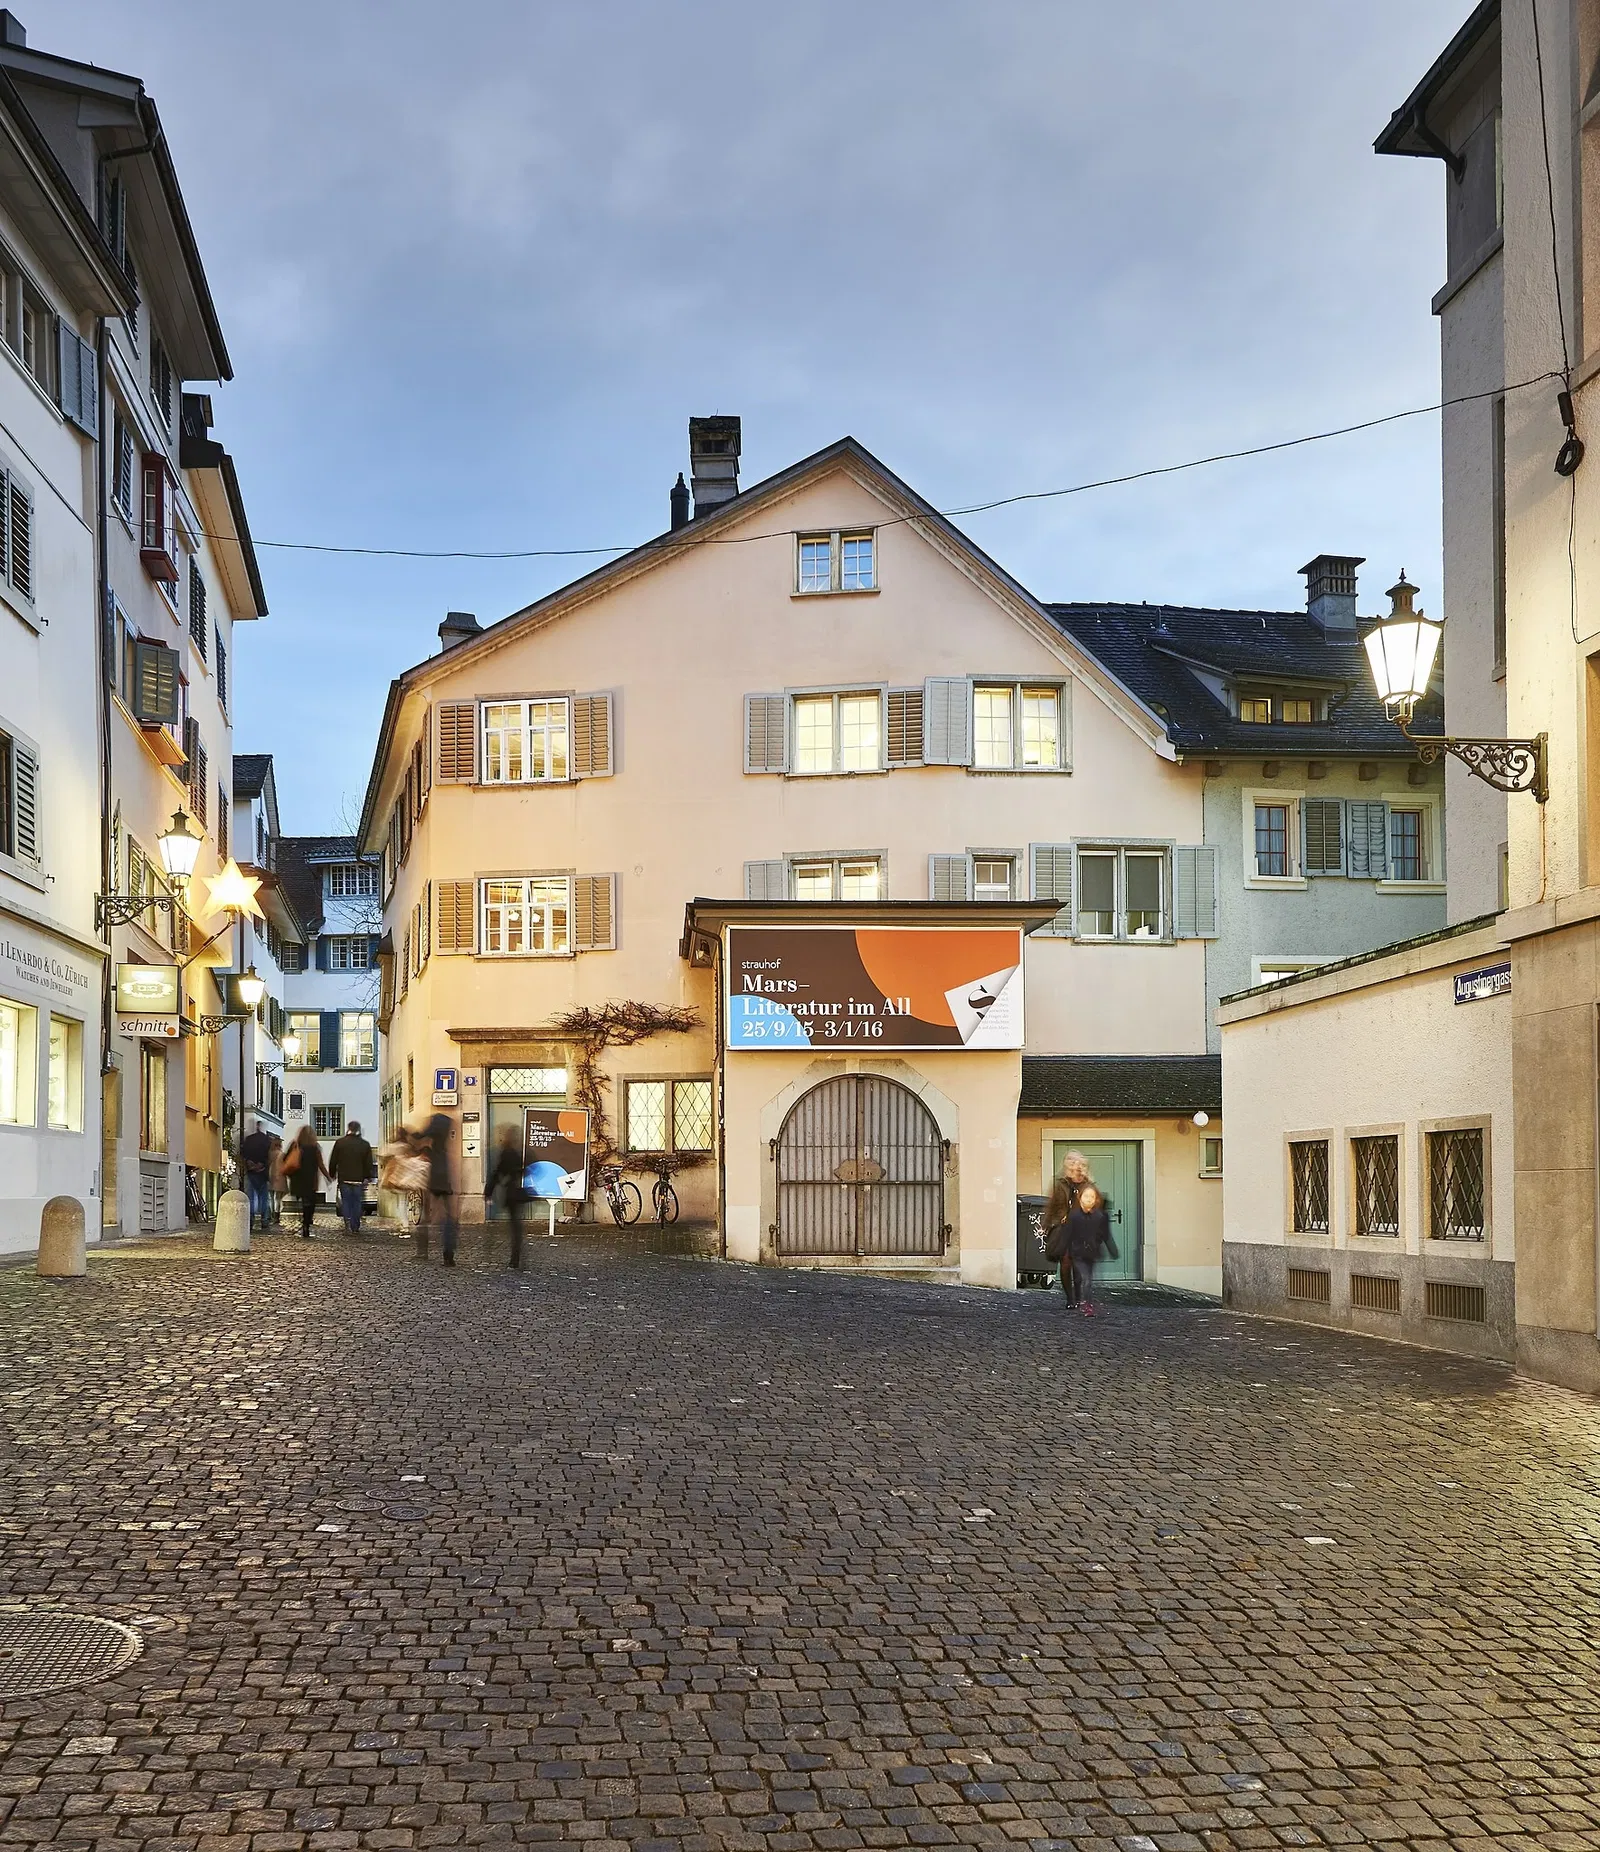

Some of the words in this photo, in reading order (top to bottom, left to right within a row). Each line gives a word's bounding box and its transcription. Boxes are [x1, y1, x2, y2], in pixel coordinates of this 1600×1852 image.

[44, 956, 50, 974] &
[741, 958, 782, 969] strauhof
[1456, 969, 1511, 999] Augustinergas
[742, 997, 842, 1016] Literatur
[847, 997, 876, 1016] im
[880, 997, 912, 1016] All
[742, 1020, 883, 1038] 25/9/15–3/1/16
[467, 1077, 473, 1085] 9
